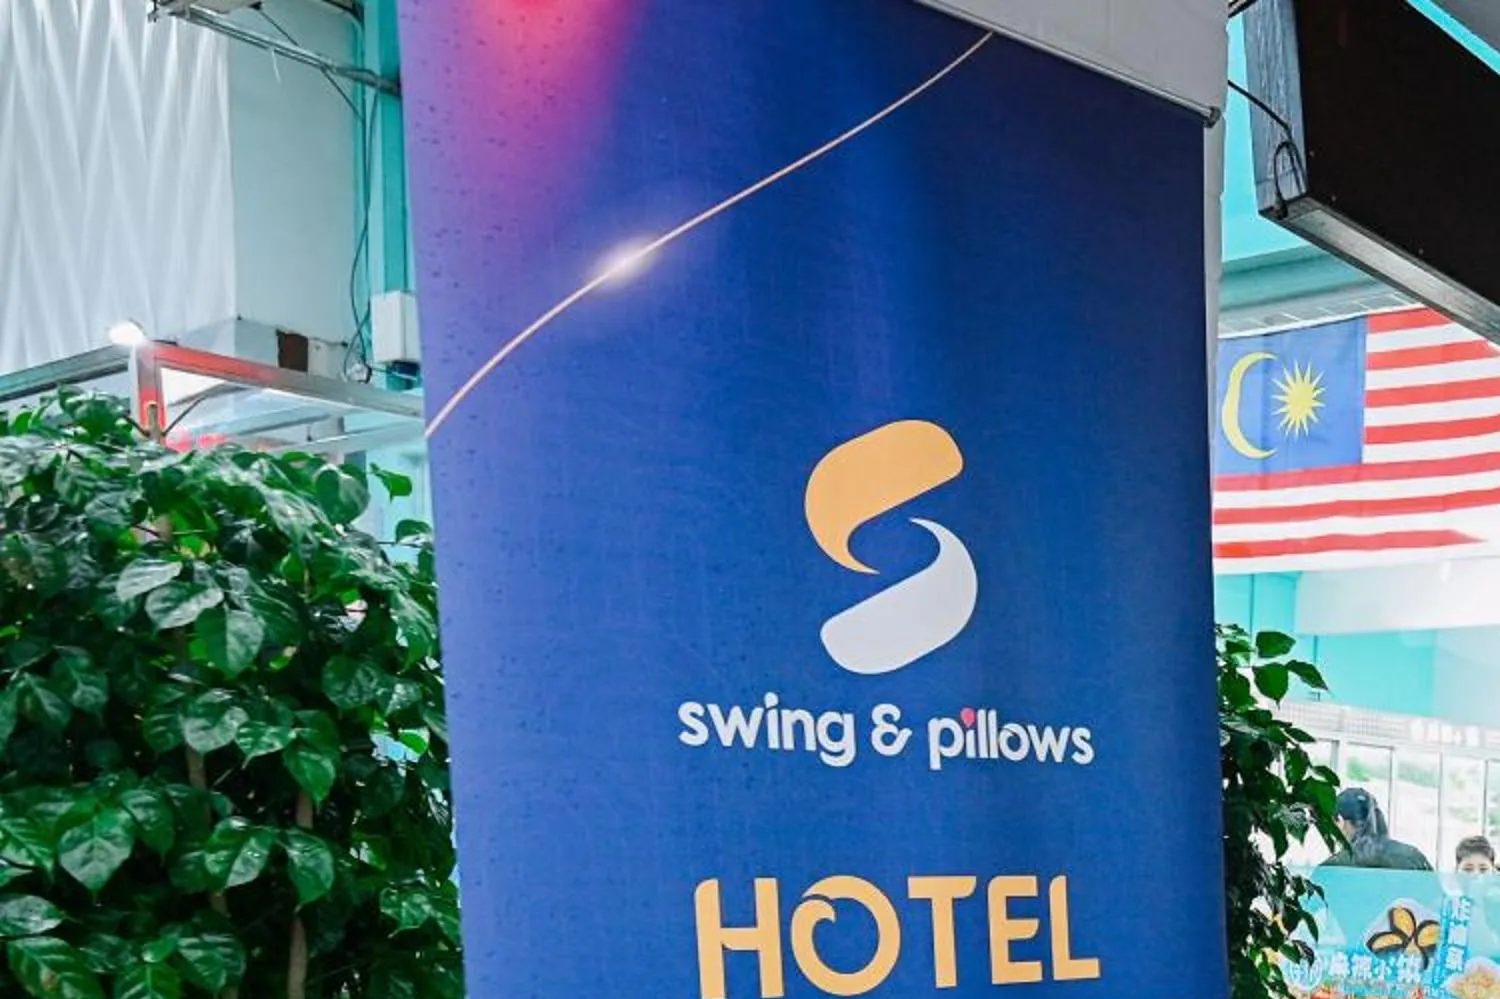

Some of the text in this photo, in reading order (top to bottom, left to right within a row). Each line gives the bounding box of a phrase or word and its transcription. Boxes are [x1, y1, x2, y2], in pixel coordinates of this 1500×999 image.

[677, 692, 1095, 770] swing & pillows
